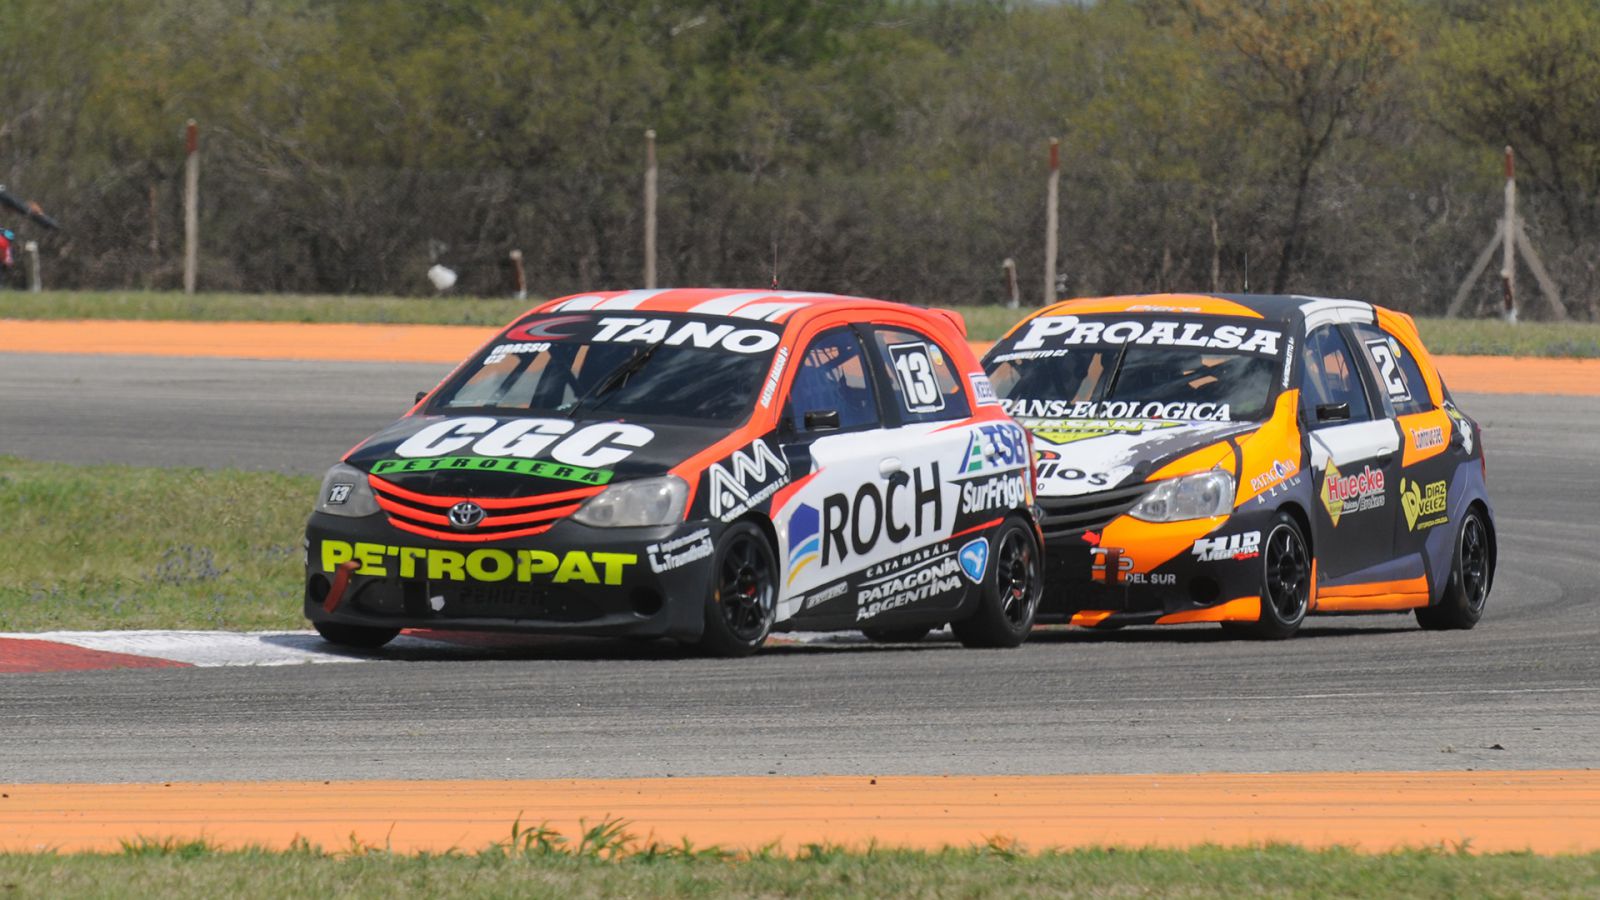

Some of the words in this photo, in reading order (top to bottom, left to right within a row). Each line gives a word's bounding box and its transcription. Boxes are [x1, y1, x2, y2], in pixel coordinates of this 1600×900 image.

[592, 318, 780, 353] TANO
[1013, 315, 1282, 354] PROALSA
[896, 352, 938, 404] 13
[1371, 345, 1406, 394] 2
[998, 399, 1231, 422] RANS-ECOLOGICA
[395, 416, 655, 468] CGC
[377, 458, 600, 482] PETROLERA
[1035, 463, 1109, 486] llos
[1327, 465, 1385, 502] Huecke
[330, 486, 350, 501] 13
[962, 474, 1025, 514] SurFrigo
[1419, 497, 1446, 514] VELEZ
[1426, 482, 1446, 499] DIAZ
[821, 460, 942, 568] ROCH
[321, 540, 637, 585] PETROPAT
[1125, 572, 1148, 584] DEL
[1150, 574, 1176, 585] SUR
